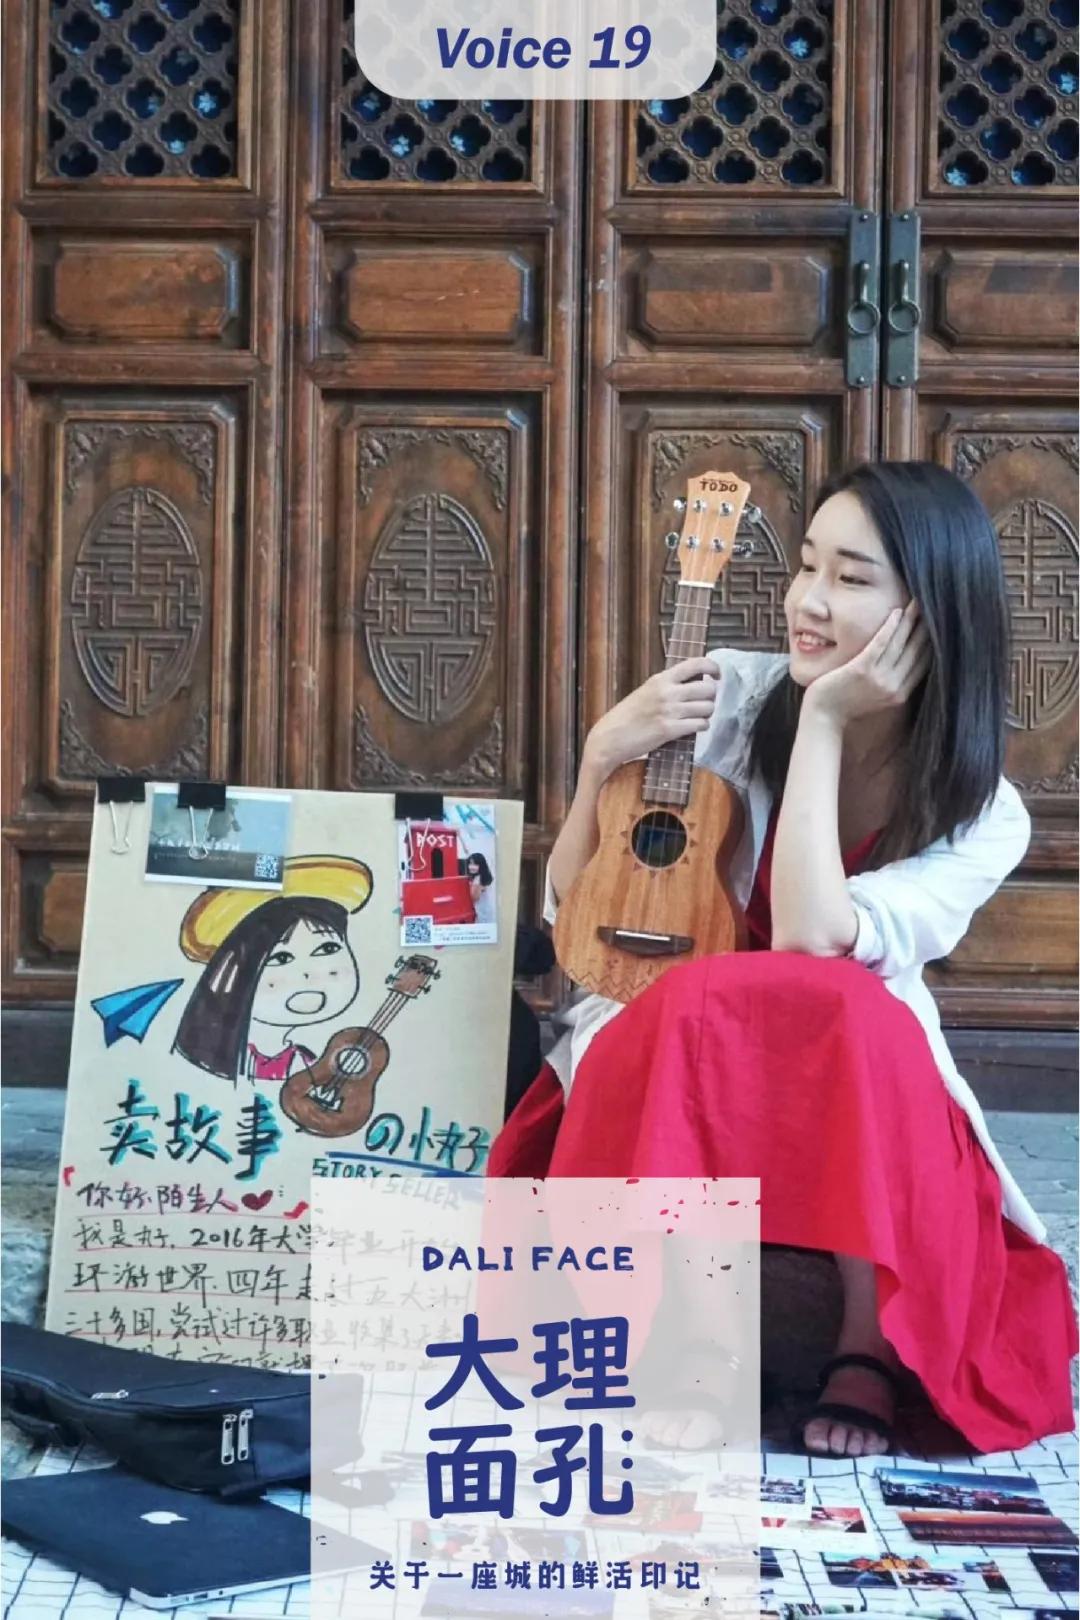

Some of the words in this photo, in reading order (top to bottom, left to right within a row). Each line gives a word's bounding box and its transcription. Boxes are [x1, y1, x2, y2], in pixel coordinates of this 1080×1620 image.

[700, 480, 738, 492] TODO
[416, 831, 454, 848] POST
[100, 1078, 281, 1181] 卖故事
